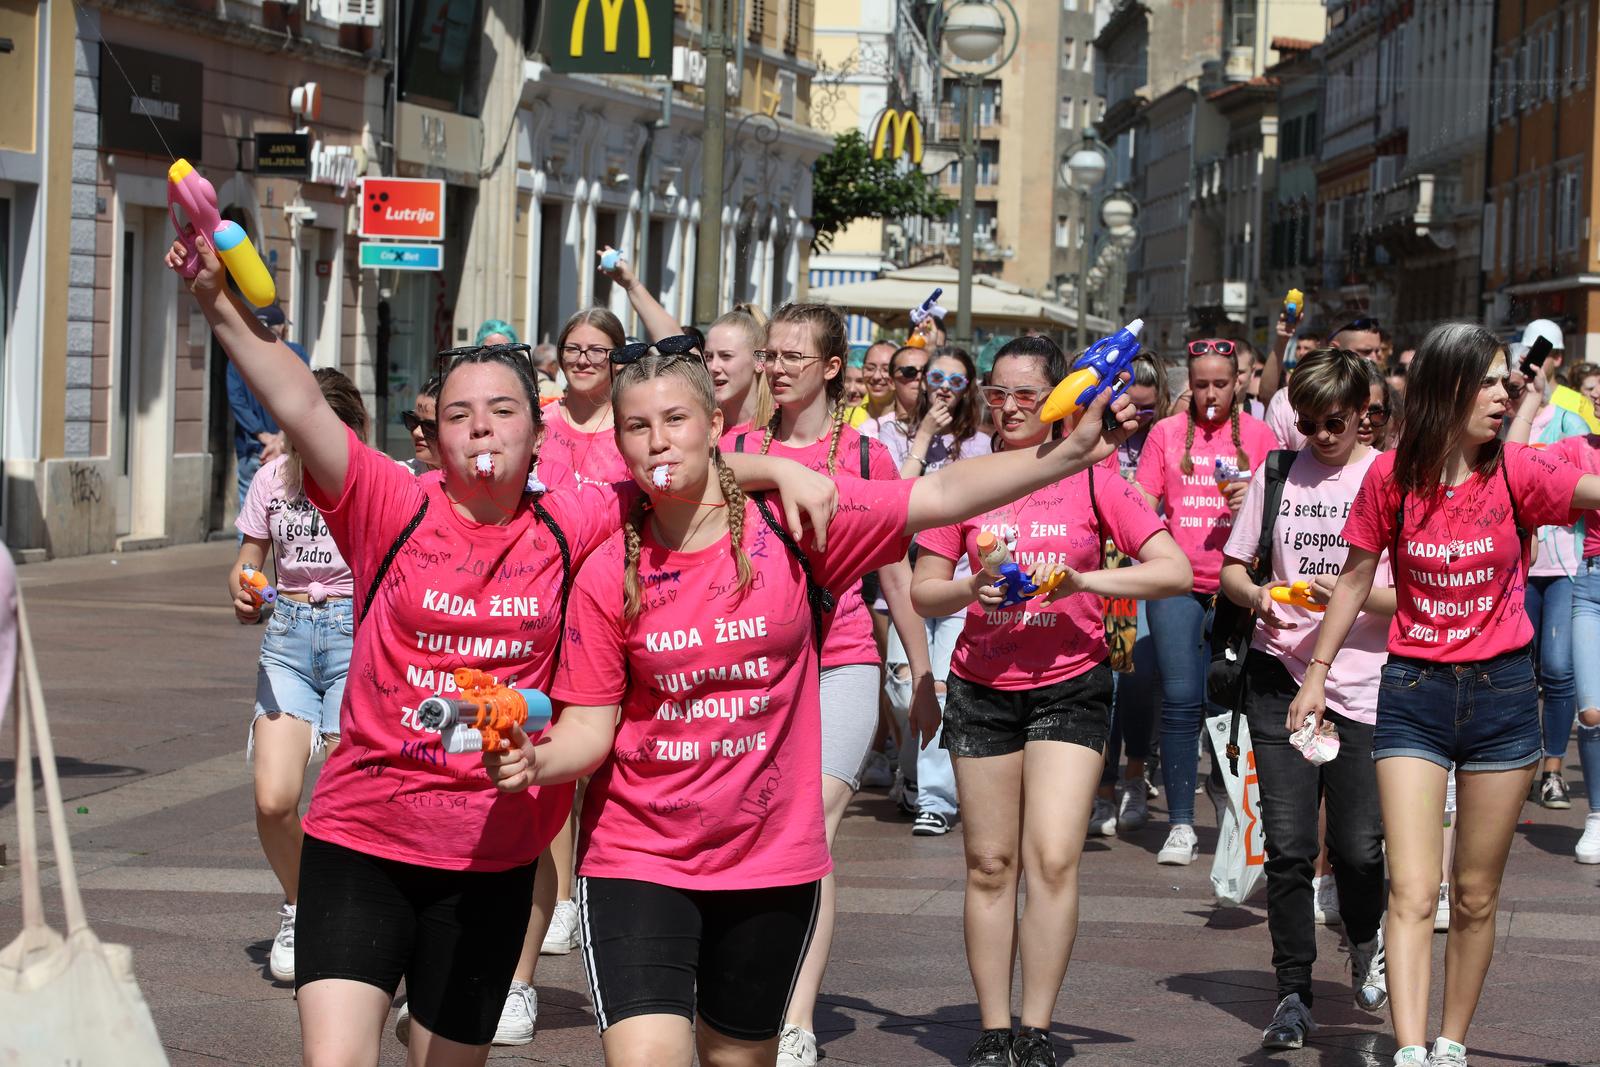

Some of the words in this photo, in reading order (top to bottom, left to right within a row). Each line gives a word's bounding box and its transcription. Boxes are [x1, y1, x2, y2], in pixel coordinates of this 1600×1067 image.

[385, 205, 436, 225] Lutrija
[1182, 495, 1225, 510] NAJBOLJI
[1294, 500, 1338, 518] sestre
[1030, 520, 1067, 538] ŽENE
[1180, 517, 1203, 528] ZUBI
[296, 546, 333, 565] Zadro
[1407, 540, 1448, 558] KADA
[1458, 537, 1494, 558] ŽENE
[1299, 556, 1340, 576] Zadro
[1408, 567, 1494, 588] TULUMARE
[422, 588, 477, 618] KADA
[489, 594, 540, 617] ŽENE
[1413, 598, 1474, 618] NAJBOLJI
[1477, 596, 1494, 612] SE
[1014, 611, 1058, 628] PRAVE
[646, 626, 702, 653] KADA
[714, 615, 768, 644] ŽENE
[1408, 623, 1440, 643] ZUBI
[415, 630, 534, 659] TULUMARE
[654, 656, 769, 693] TULUMARE
[656, 697, 744, 724] NAJBOLJI
[749, 695, 770, 715] SE
[656, 740, 700, 761] ZUBI
[710, 731, 767, 758] PRAVE
